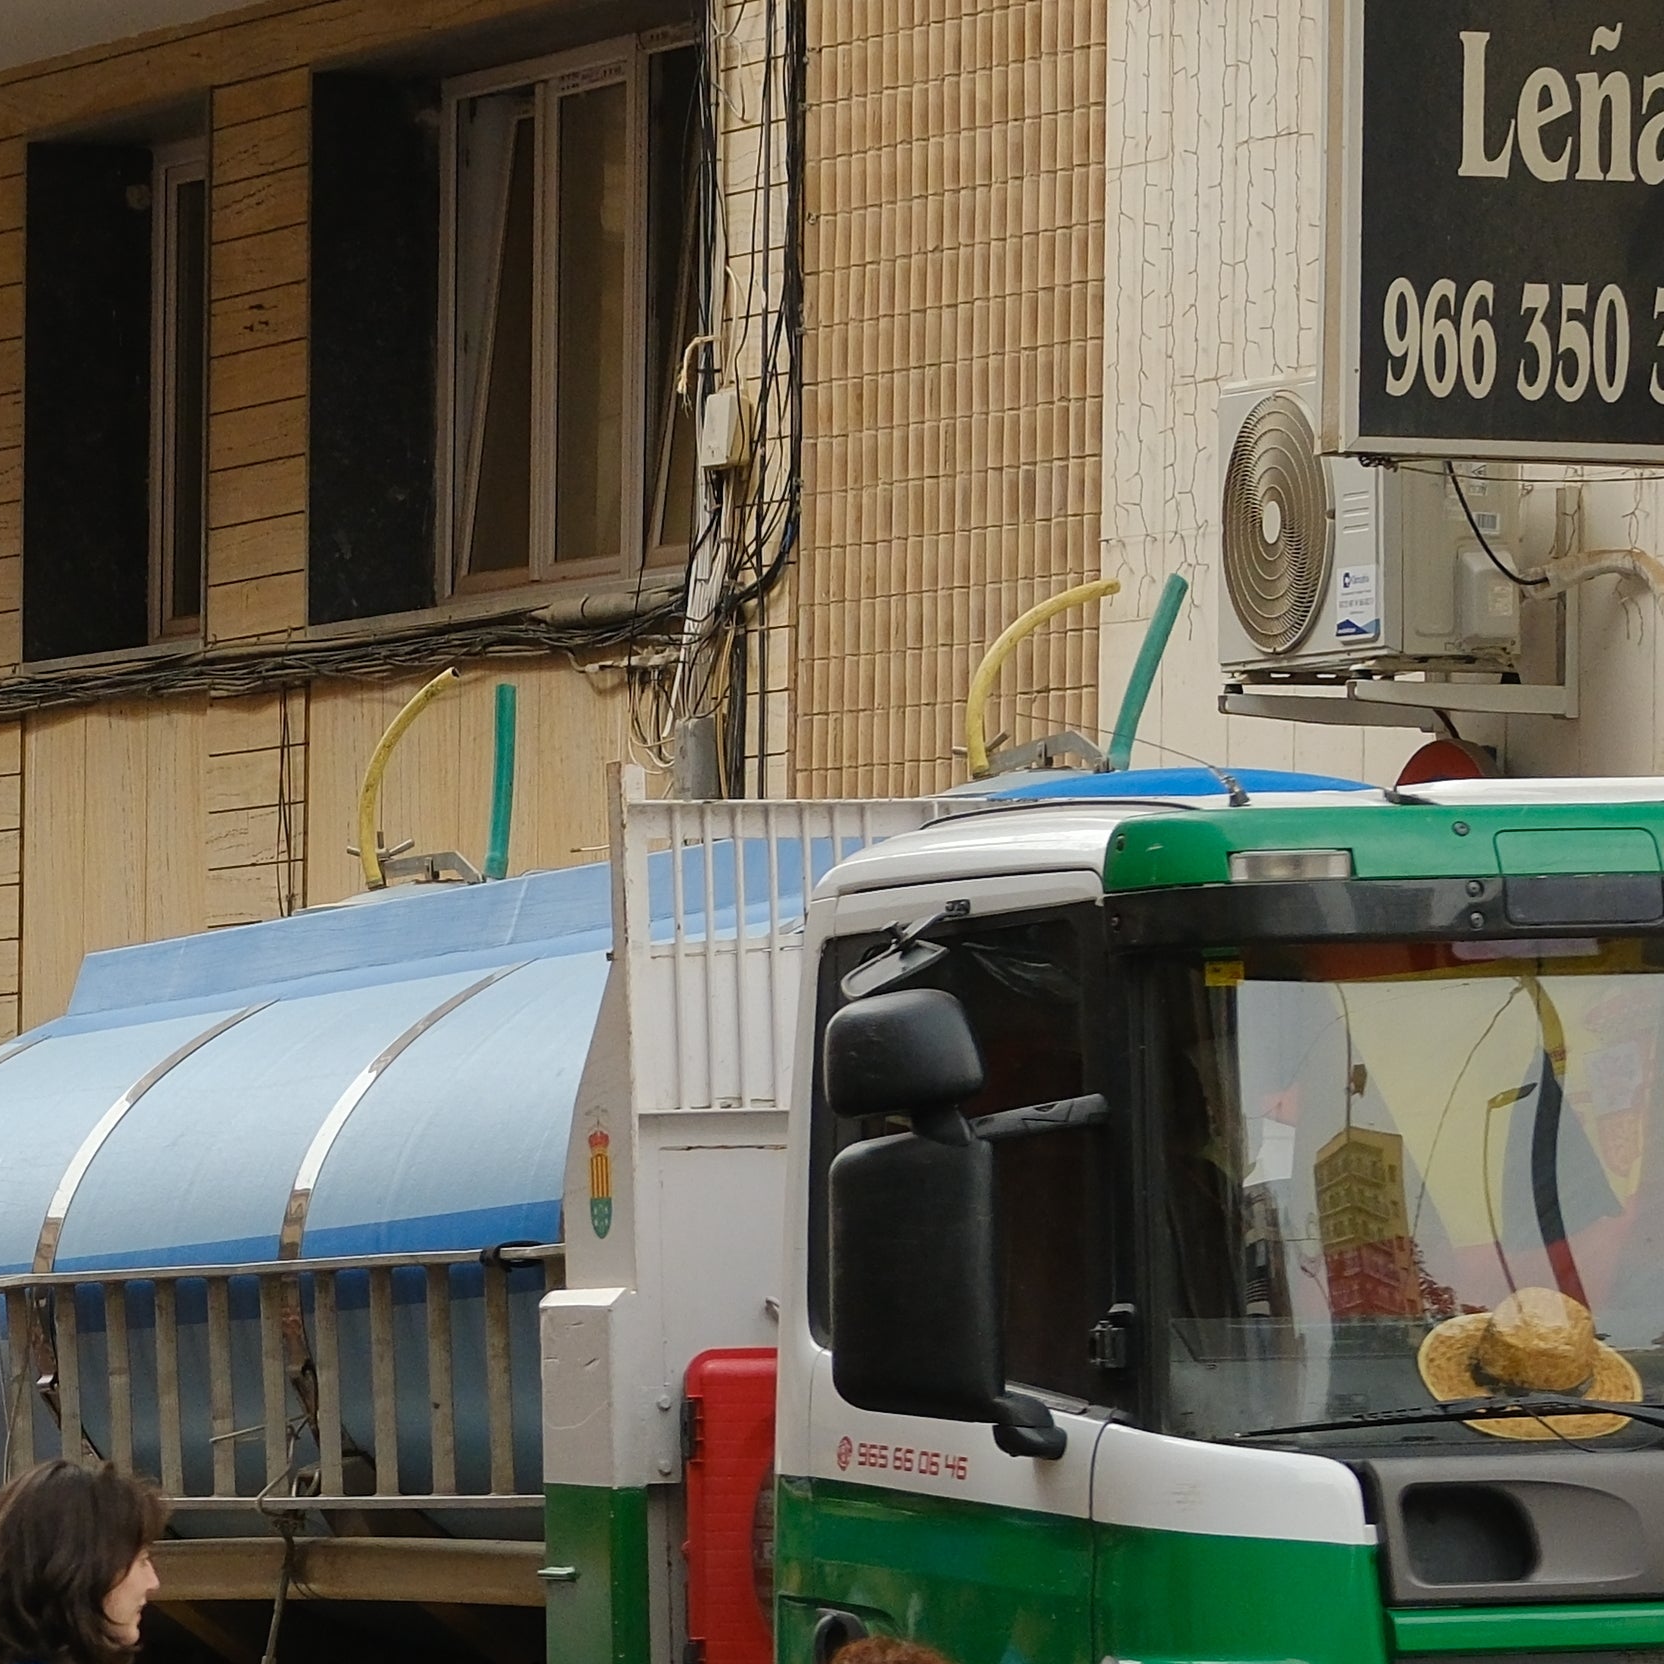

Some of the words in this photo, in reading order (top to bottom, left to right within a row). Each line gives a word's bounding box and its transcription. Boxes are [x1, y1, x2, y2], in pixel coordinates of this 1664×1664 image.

[1383, 276, 1497, 399] 966
[1516, 281, 1630, 403] 350
[857, 1442, 889, 1469] 965
[893, 1447, 914, 1472] 66
[918, 1450, 941, 1476] 06
[944, 1454, 968, 1480] 46
